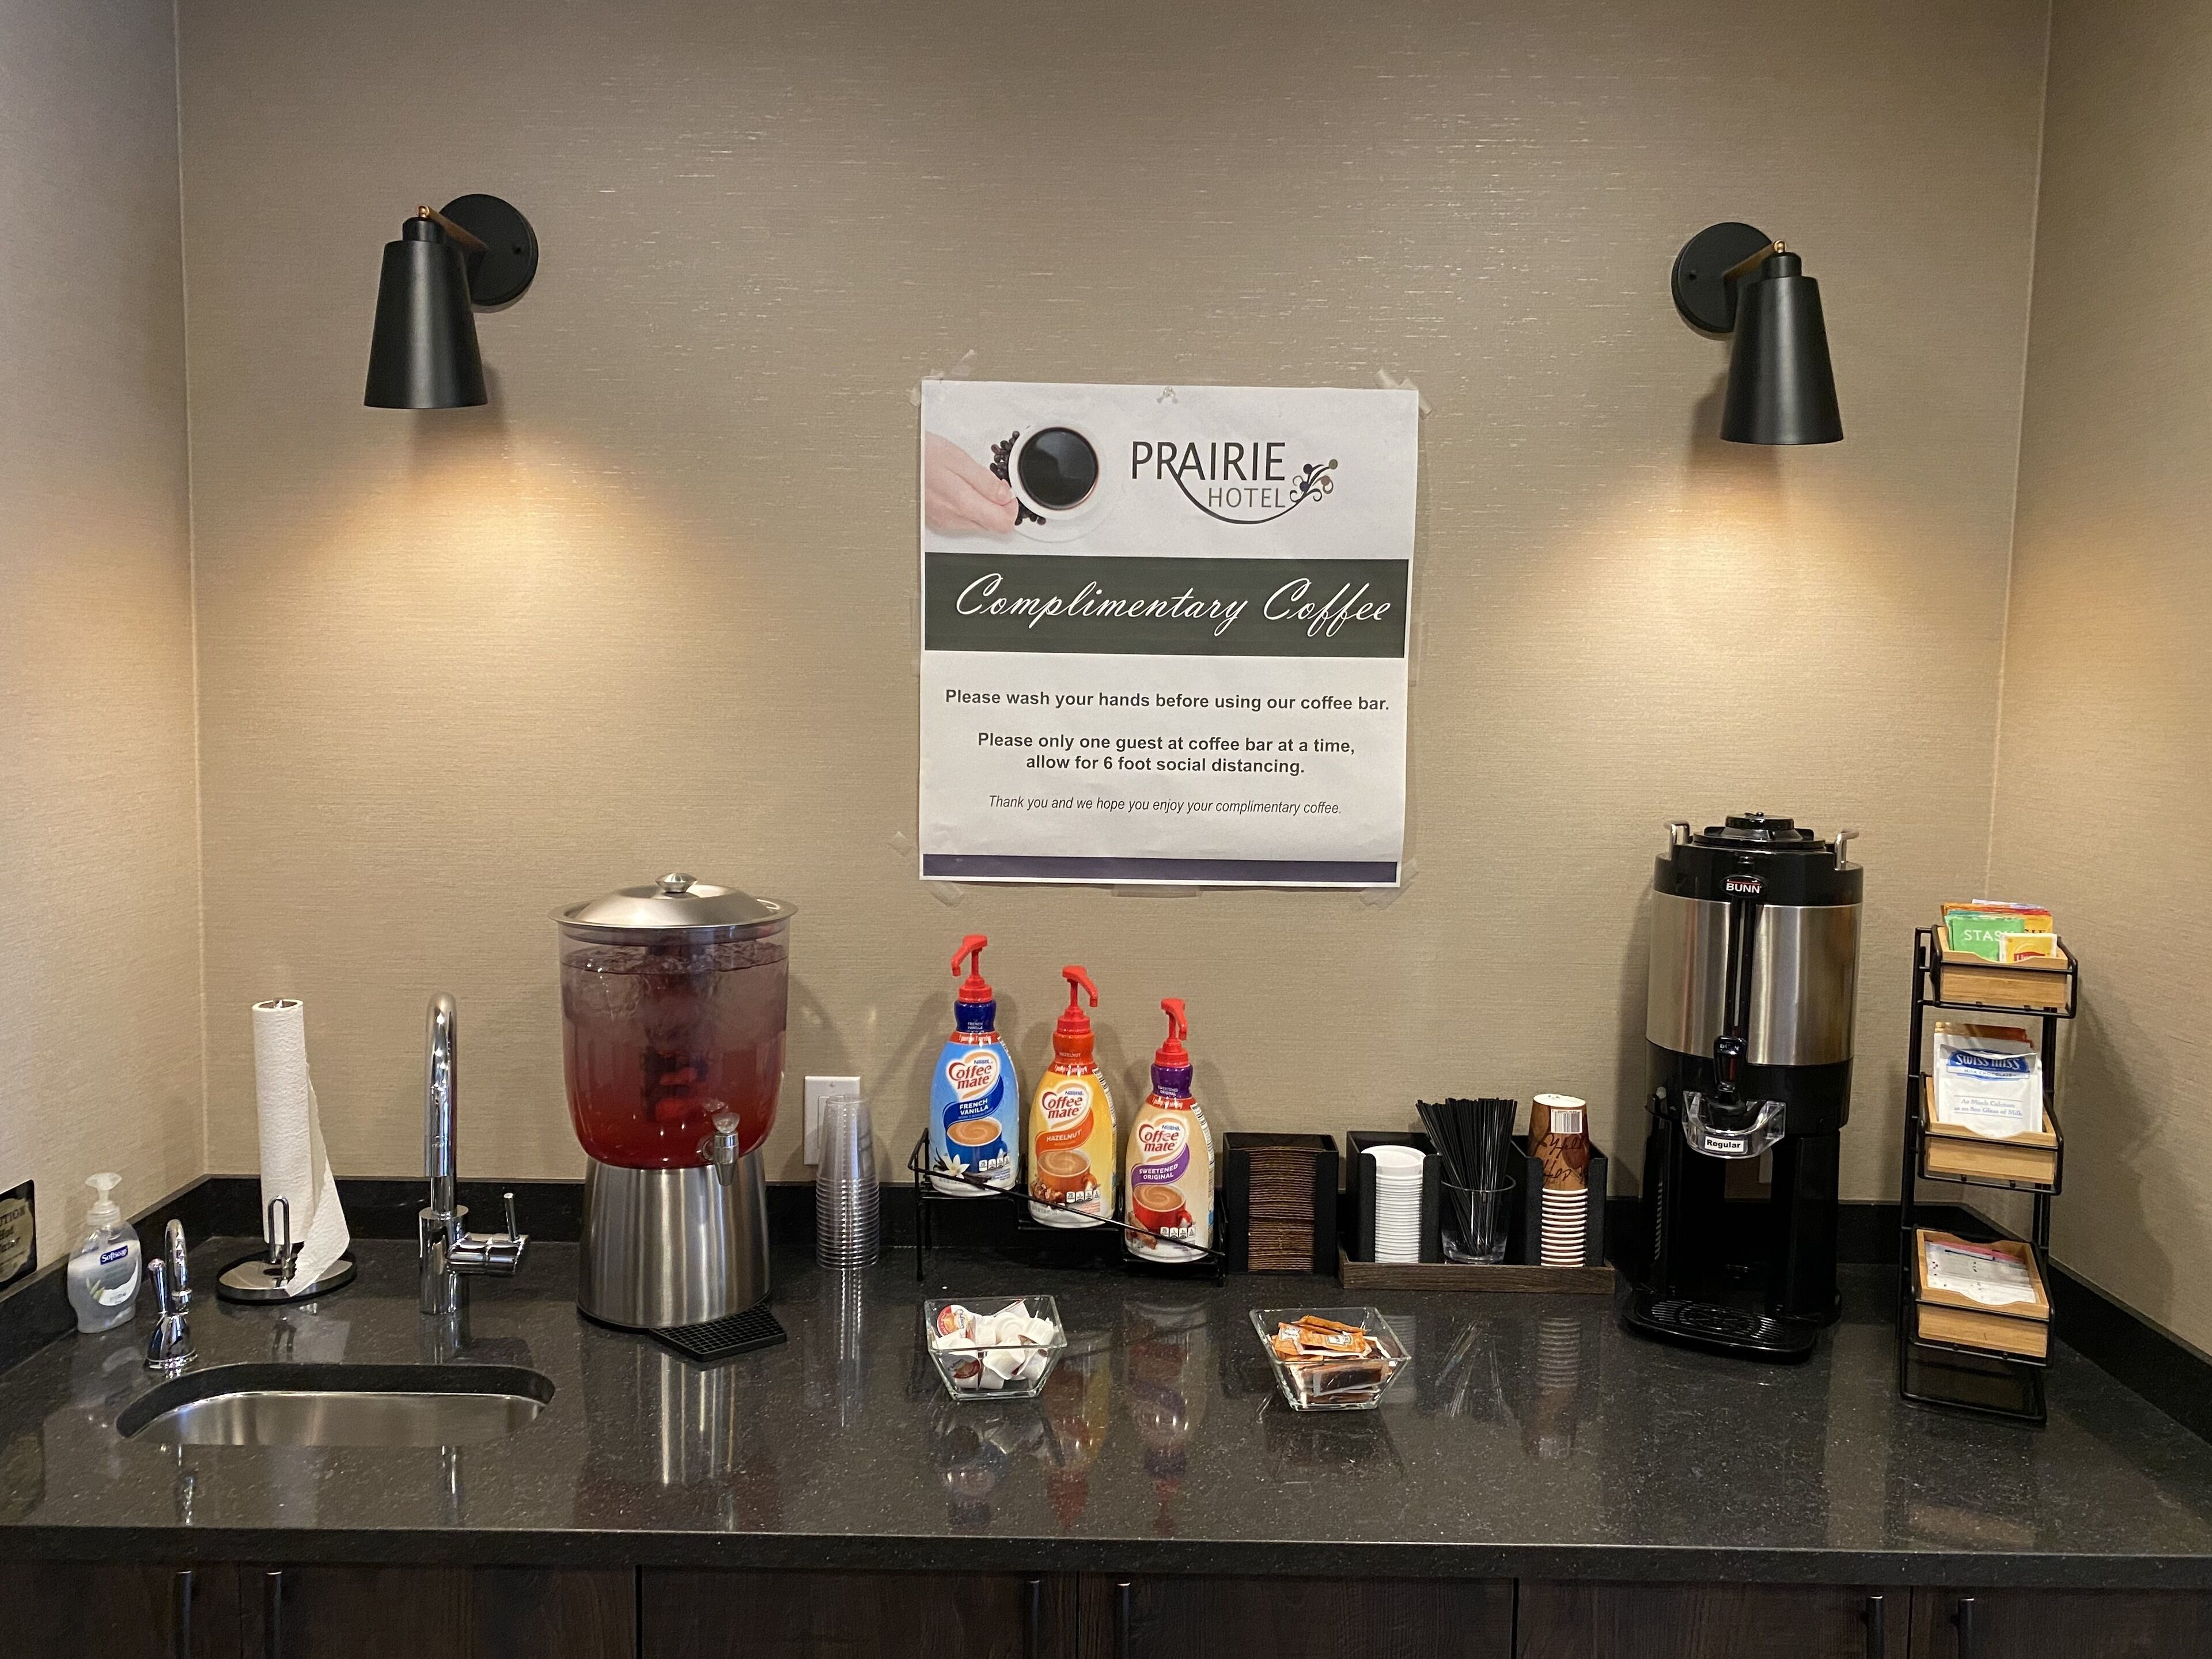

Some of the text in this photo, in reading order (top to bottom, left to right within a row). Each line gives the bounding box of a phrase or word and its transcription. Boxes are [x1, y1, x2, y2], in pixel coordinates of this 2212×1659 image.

[1132, 441, 1286, 482] PRAIRIE
[1209, 487, 1286, 509] HOTEL
[956, 572, 1391, 638] Complimentary Coffee
[946, 690, 1389, 712] Please wash your hands before using our coffee bar.
[978, 732, 1354, 755] Please only one guest at coffee bar at a time,
[1027, 755, 1304, 777] allow for 6 foot social distancing.
[990, 795, 1342, 816] Thank you and we hope you enjoy your complimentary coffee.
[1726, 882, 1760, 893] BUNN
[1964, 929, 2014, 941] STAS
[948, 1062, 993, 1081] Coffee
[957, 1075, 990, 1090] mate
[959, 1099, 988, 1110] FRENCH
[1041, 1092, 1084, 1111] Coffee
[960, 1104, 990, 1116] VANILLA
[1048, 1107, 1080, 1119] mate
[1046, 1129, 1082, 1142] HAZELNUT
[1138, 1123, 1179, 1143] Coffee
[1143, 1142, 1175, 1152] mate
[1707, 1139, 1741, 1150] Regular
[1139, 1163, 1179, 1175] SWEETENED
[1143, 1172, 1175, 1180] ORIGINAL
[101, 1248, 127, 1263] Softsoap
